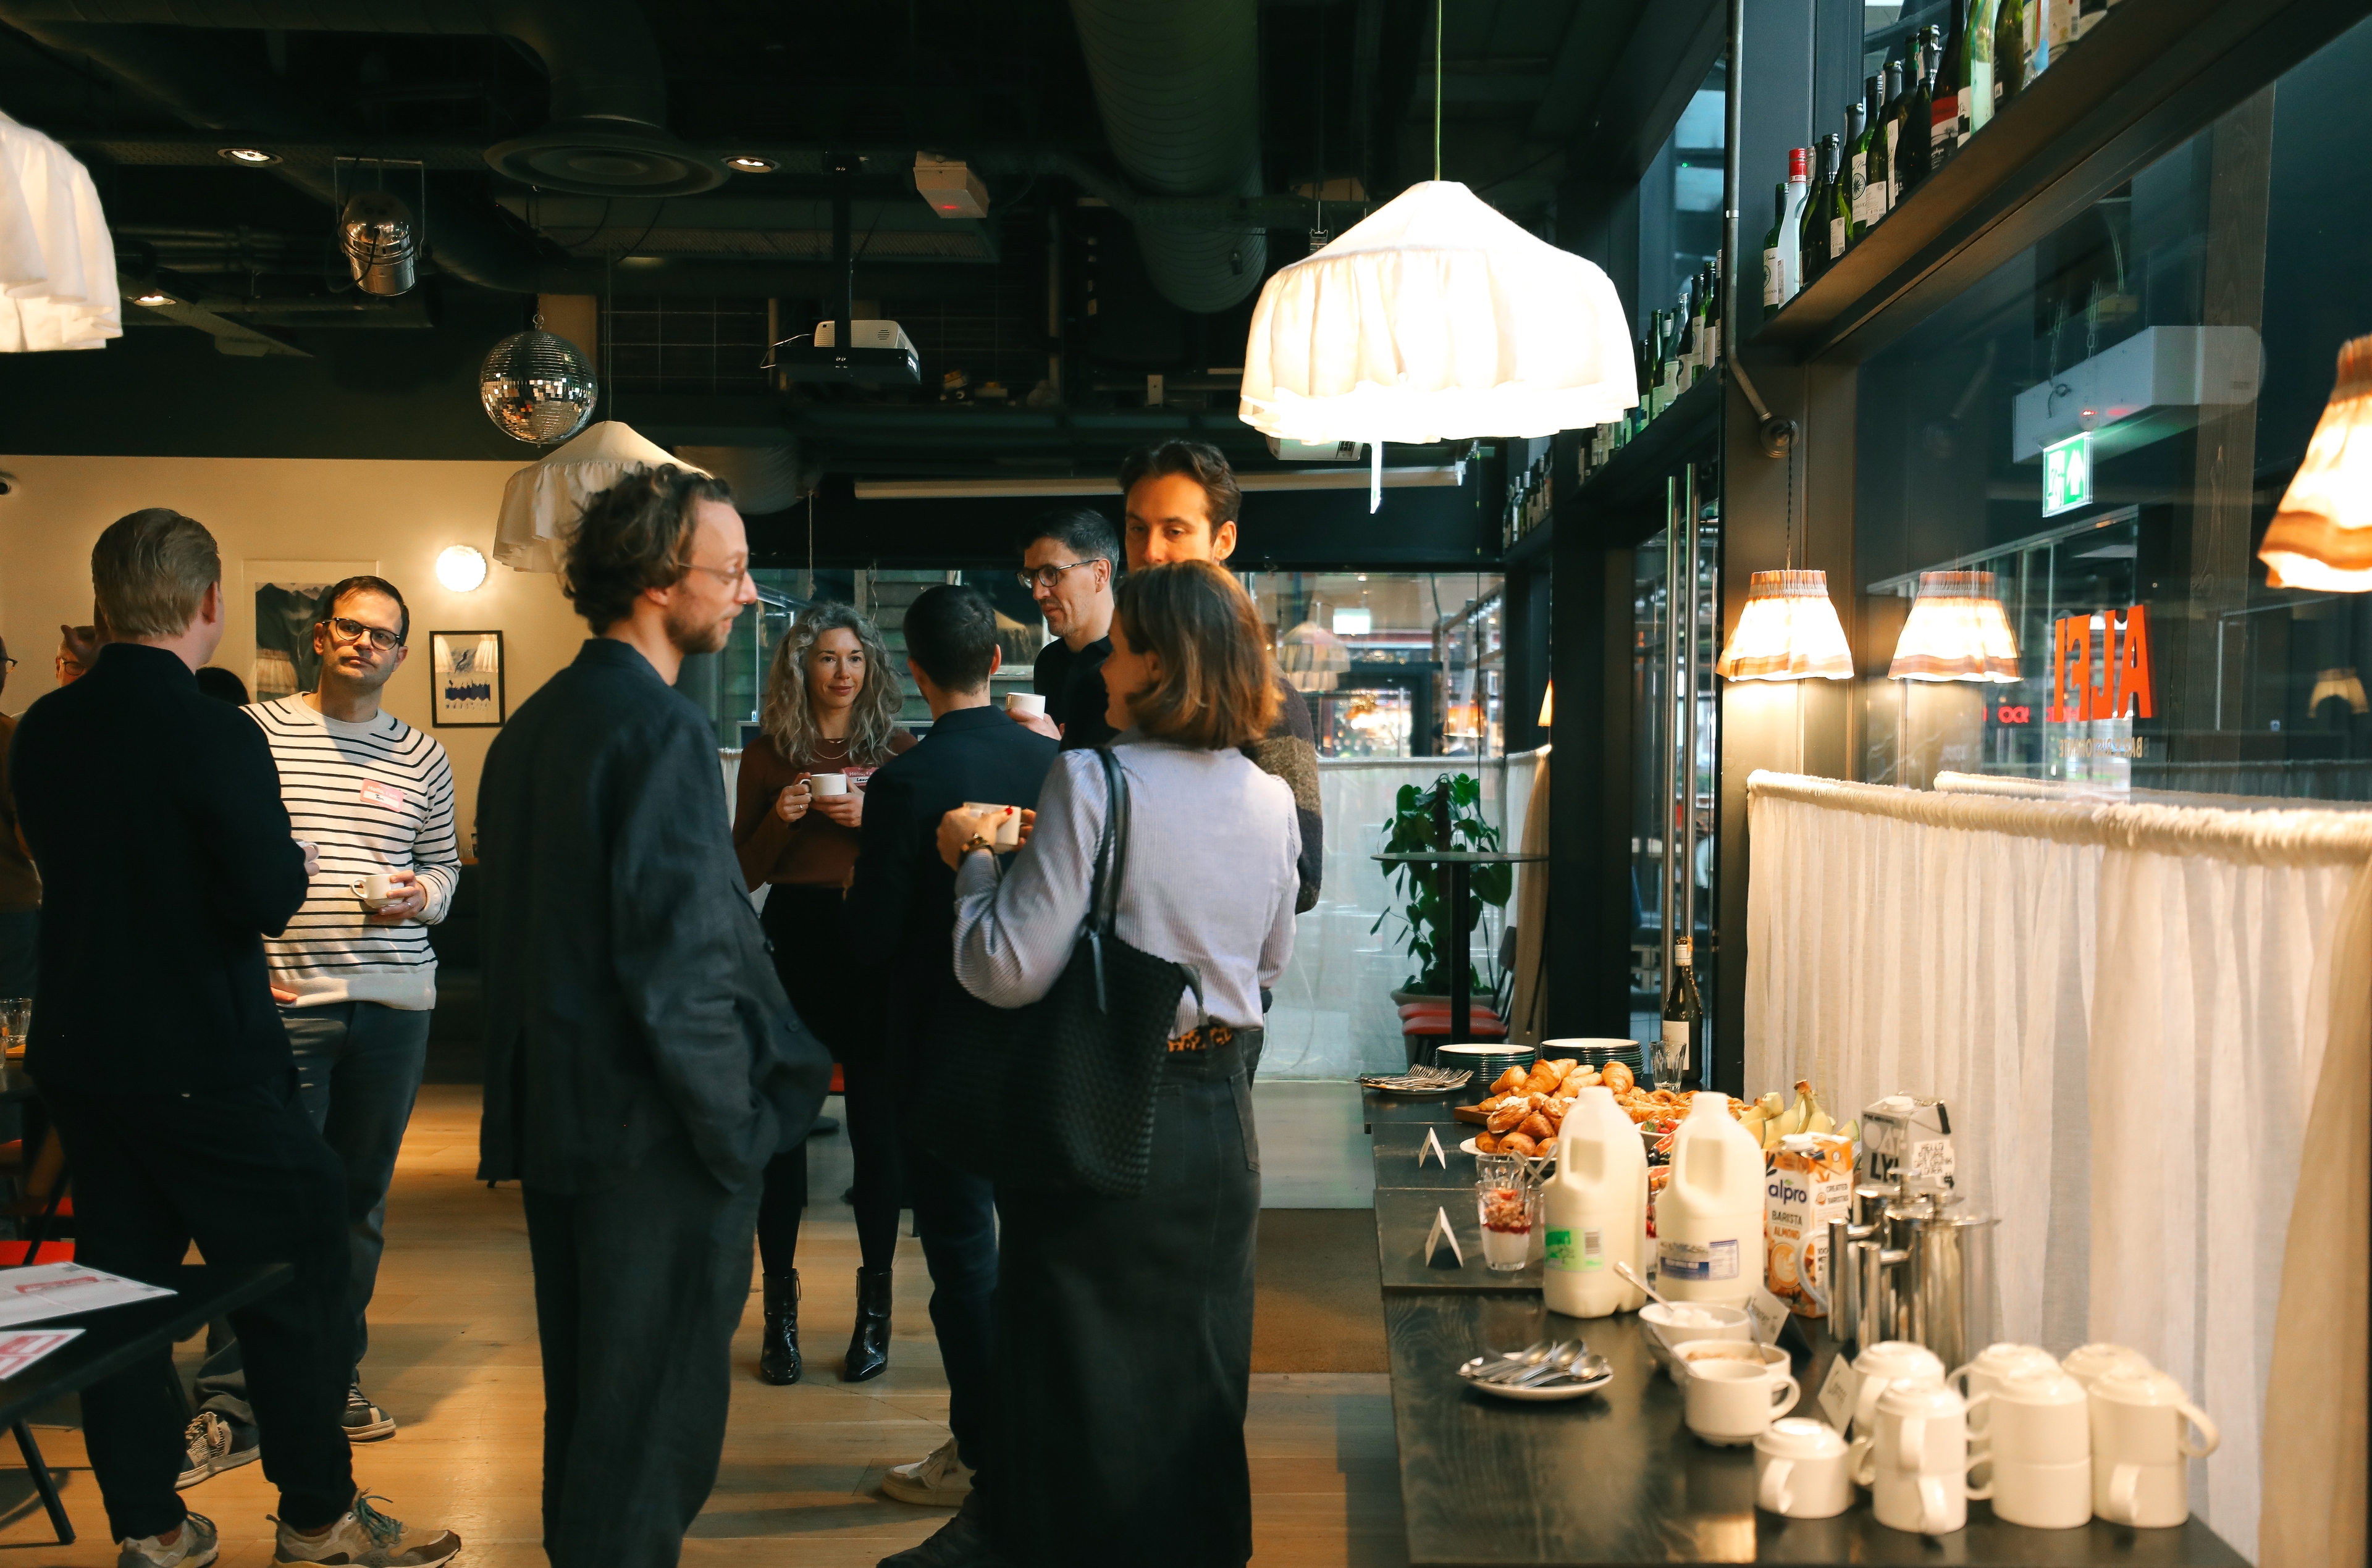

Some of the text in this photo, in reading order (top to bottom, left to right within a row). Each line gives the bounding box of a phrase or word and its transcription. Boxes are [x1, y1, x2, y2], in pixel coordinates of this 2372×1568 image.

[1768, 1179, 1807, 1205] alpro
[1772, 1210, 1802, 1226] BARISTA
[1774, 1226, 1801, 1240] ALMOND
